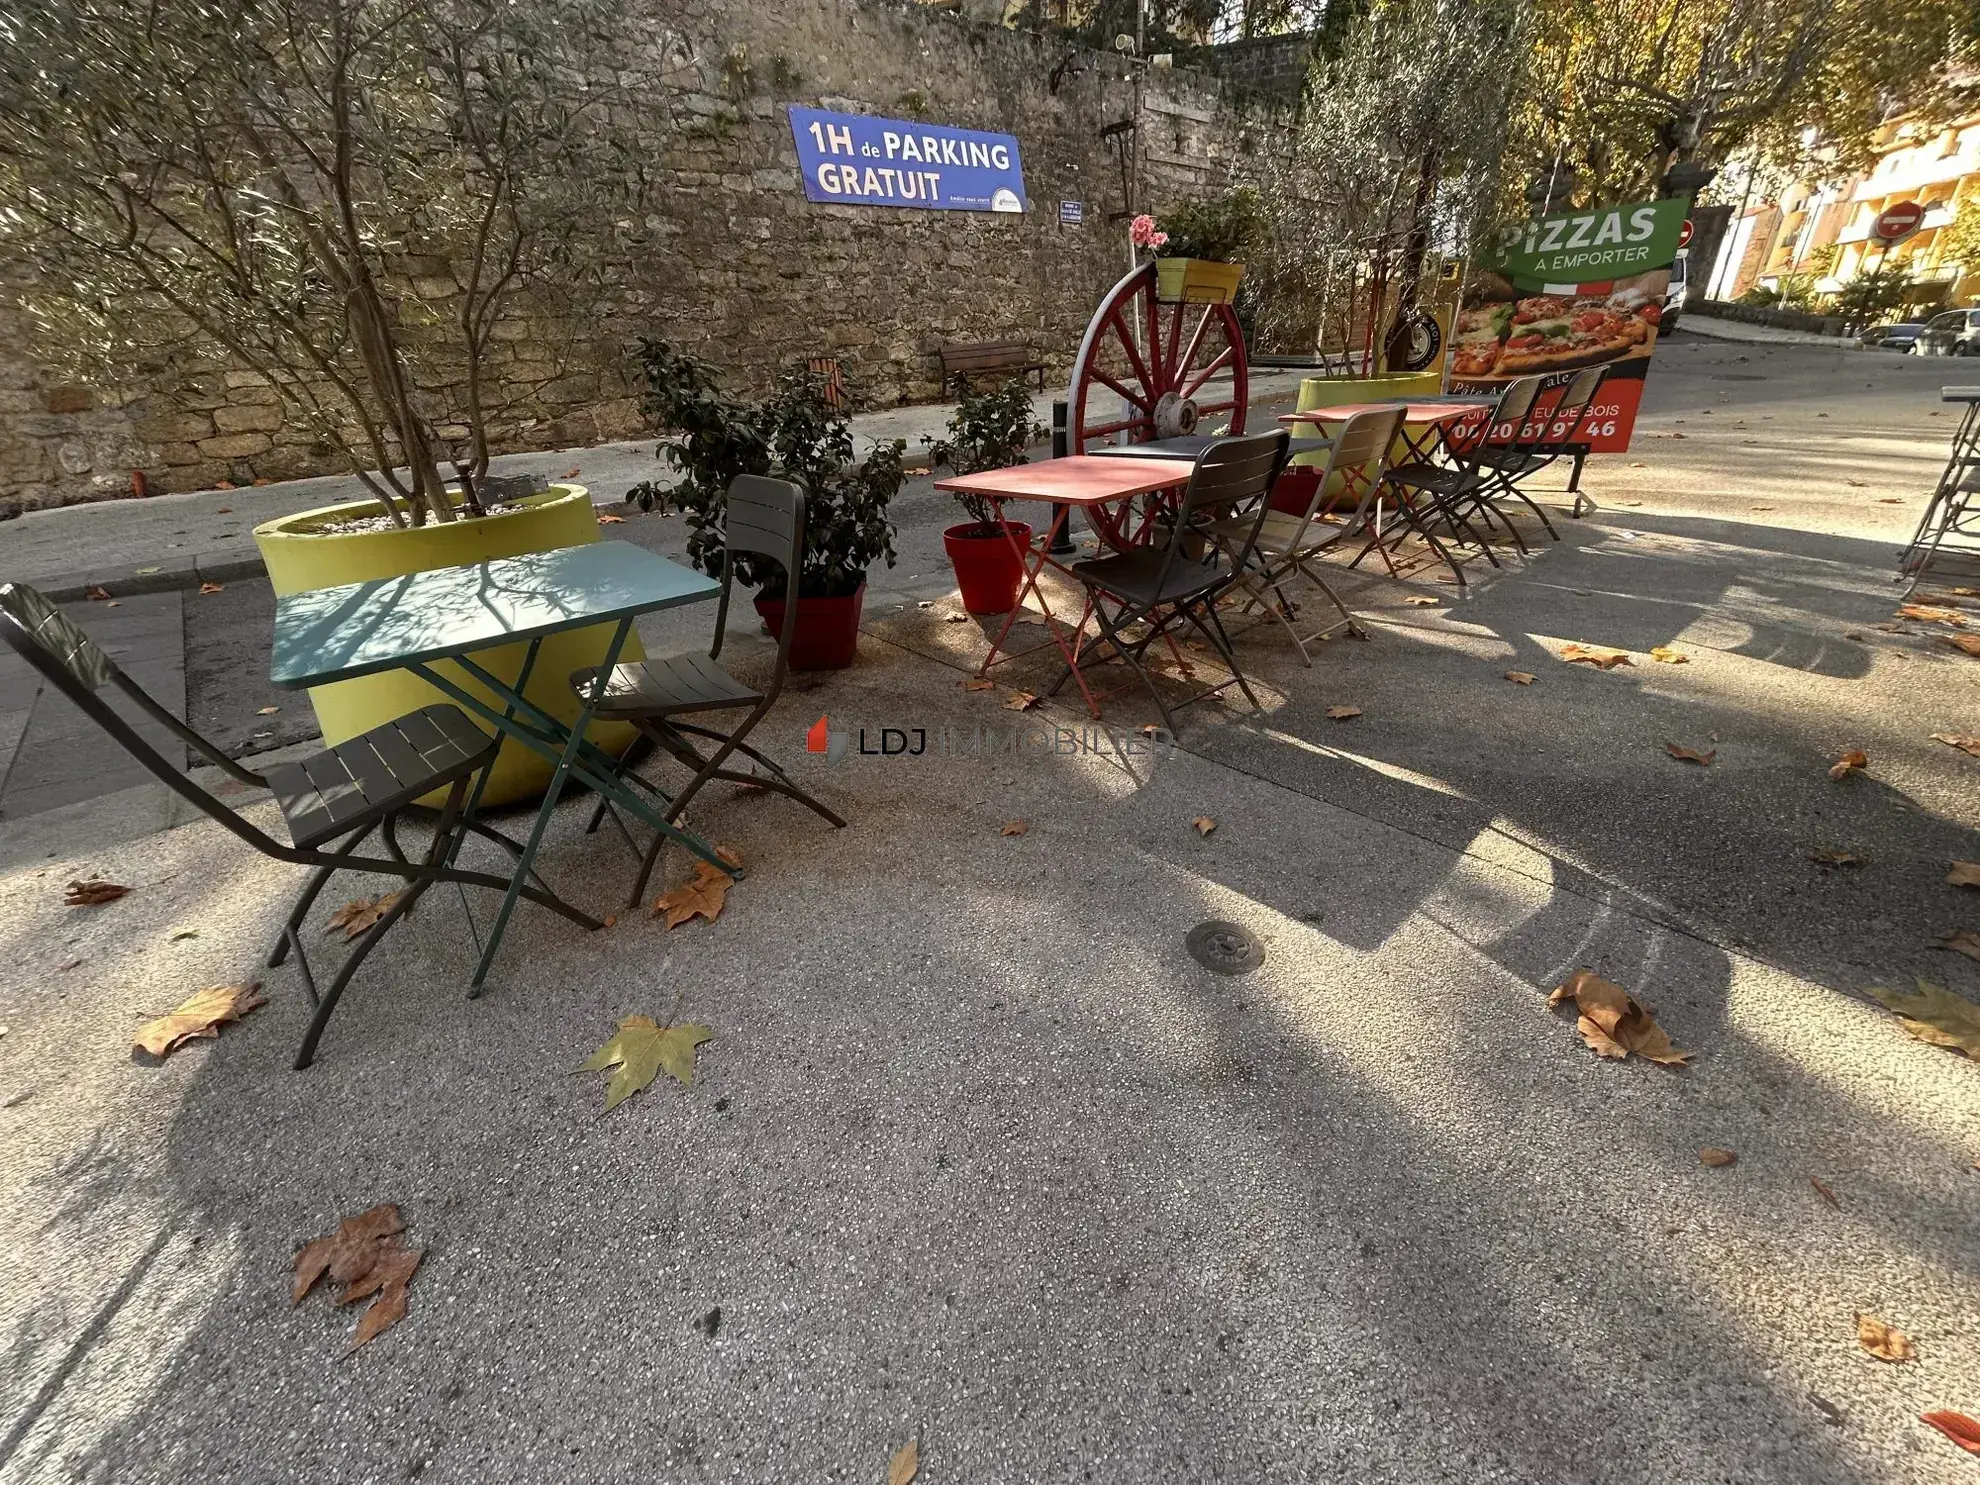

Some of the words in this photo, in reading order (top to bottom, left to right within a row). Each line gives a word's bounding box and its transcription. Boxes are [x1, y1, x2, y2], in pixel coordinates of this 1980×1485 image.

[808, 121, 855, 156] 1H
[861, 141, 881, 158] de
[883, 131, 1010, 170] PARKING
[817, 162, 941, 200] GRATUIT
[1534, 258, 1547, 272] A
[1552, 246, 1650, 270] EMPORTER
[1533, 406, 1555, 419] EU
[1583, 404, 1620, 418] BOIS
[1521, 422, 1545, 438] 61
[1586, 421, 1616, 437] 46
